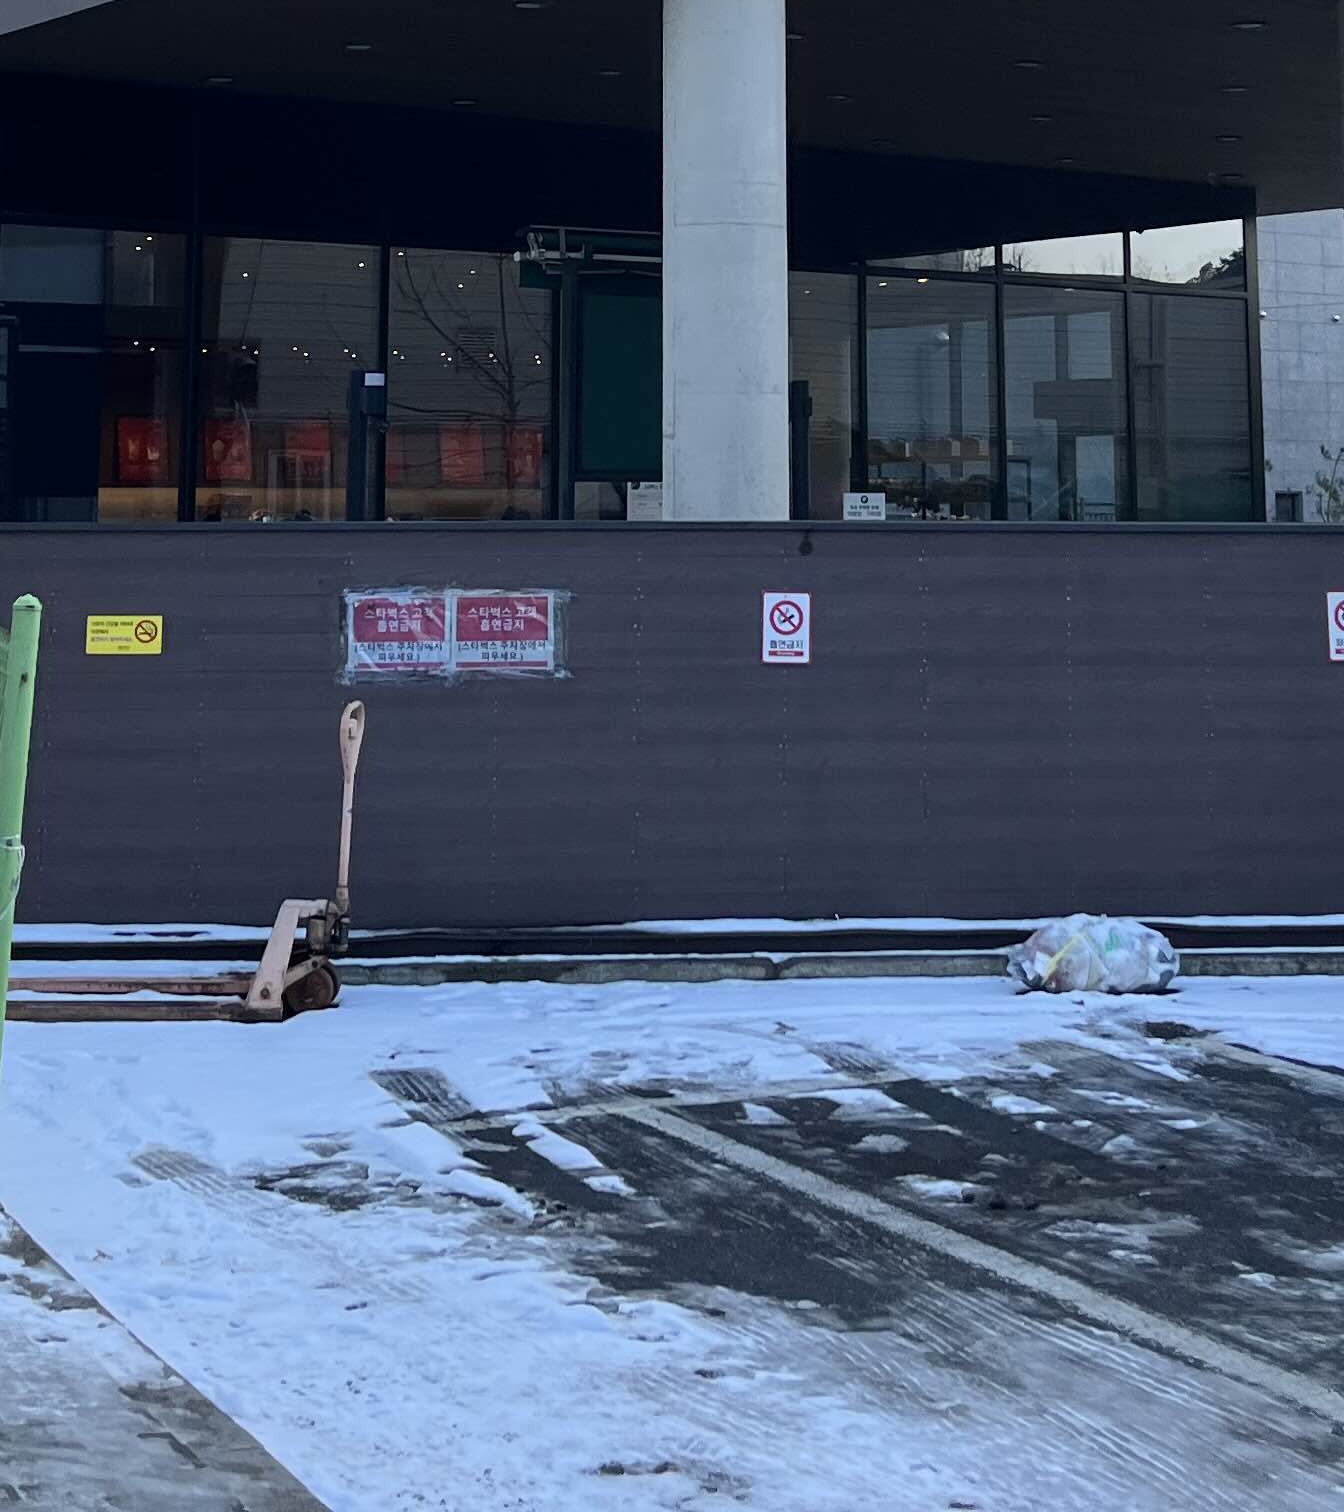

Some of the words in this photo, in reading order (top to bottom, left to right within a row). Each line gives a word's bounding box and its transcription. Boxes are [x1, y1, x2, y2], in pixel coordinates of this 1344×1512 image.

[364, 607, 409, 619] 스타벅스
[467, 607, 512, 618] 스타벅스
[480, 619, 525, 632] 흡연금지
